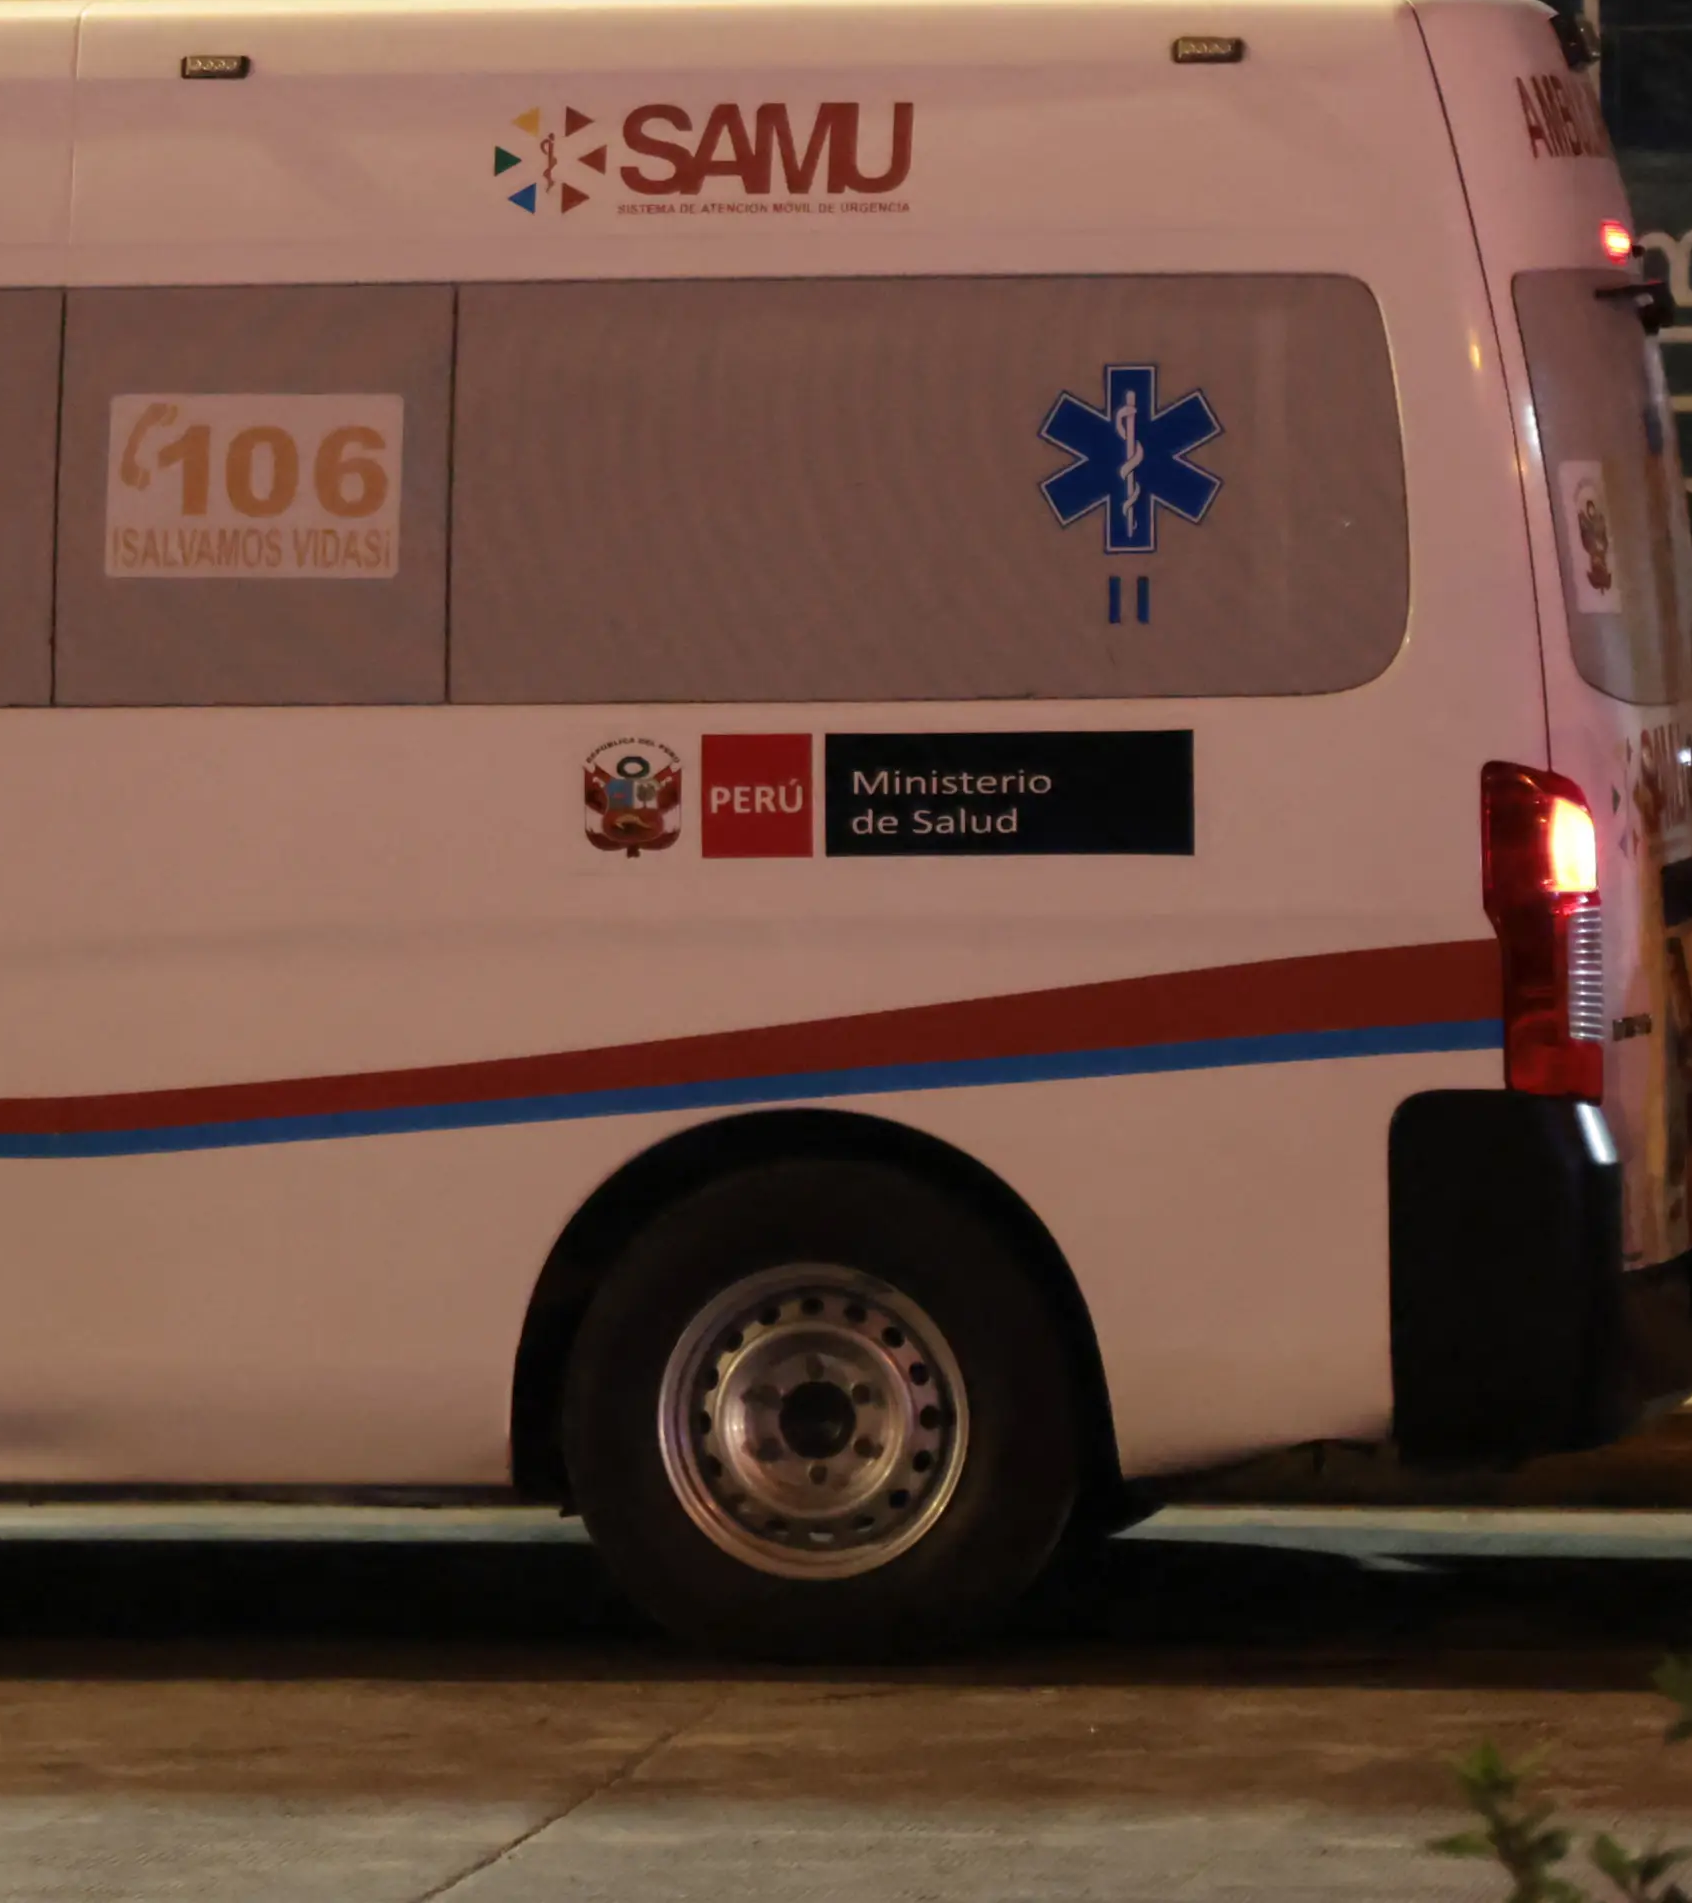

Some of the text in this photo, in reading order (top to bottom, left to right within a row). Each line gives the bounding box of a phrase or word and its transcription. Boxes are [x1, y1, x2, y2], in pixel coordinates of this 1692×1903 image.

[620, 101, 914, 196] SAMU
[617, 202, 676, 215] SISTEMA
[679, 202, 697, 215] DE
[818, 202, 837, 214] DE
[158, 424, 390, 518] 106
[709, 778, 805, 815] PERÚ
[851, 769, 1053, 796] Ministerio
[851, 808, 1019, 835] de Salud
